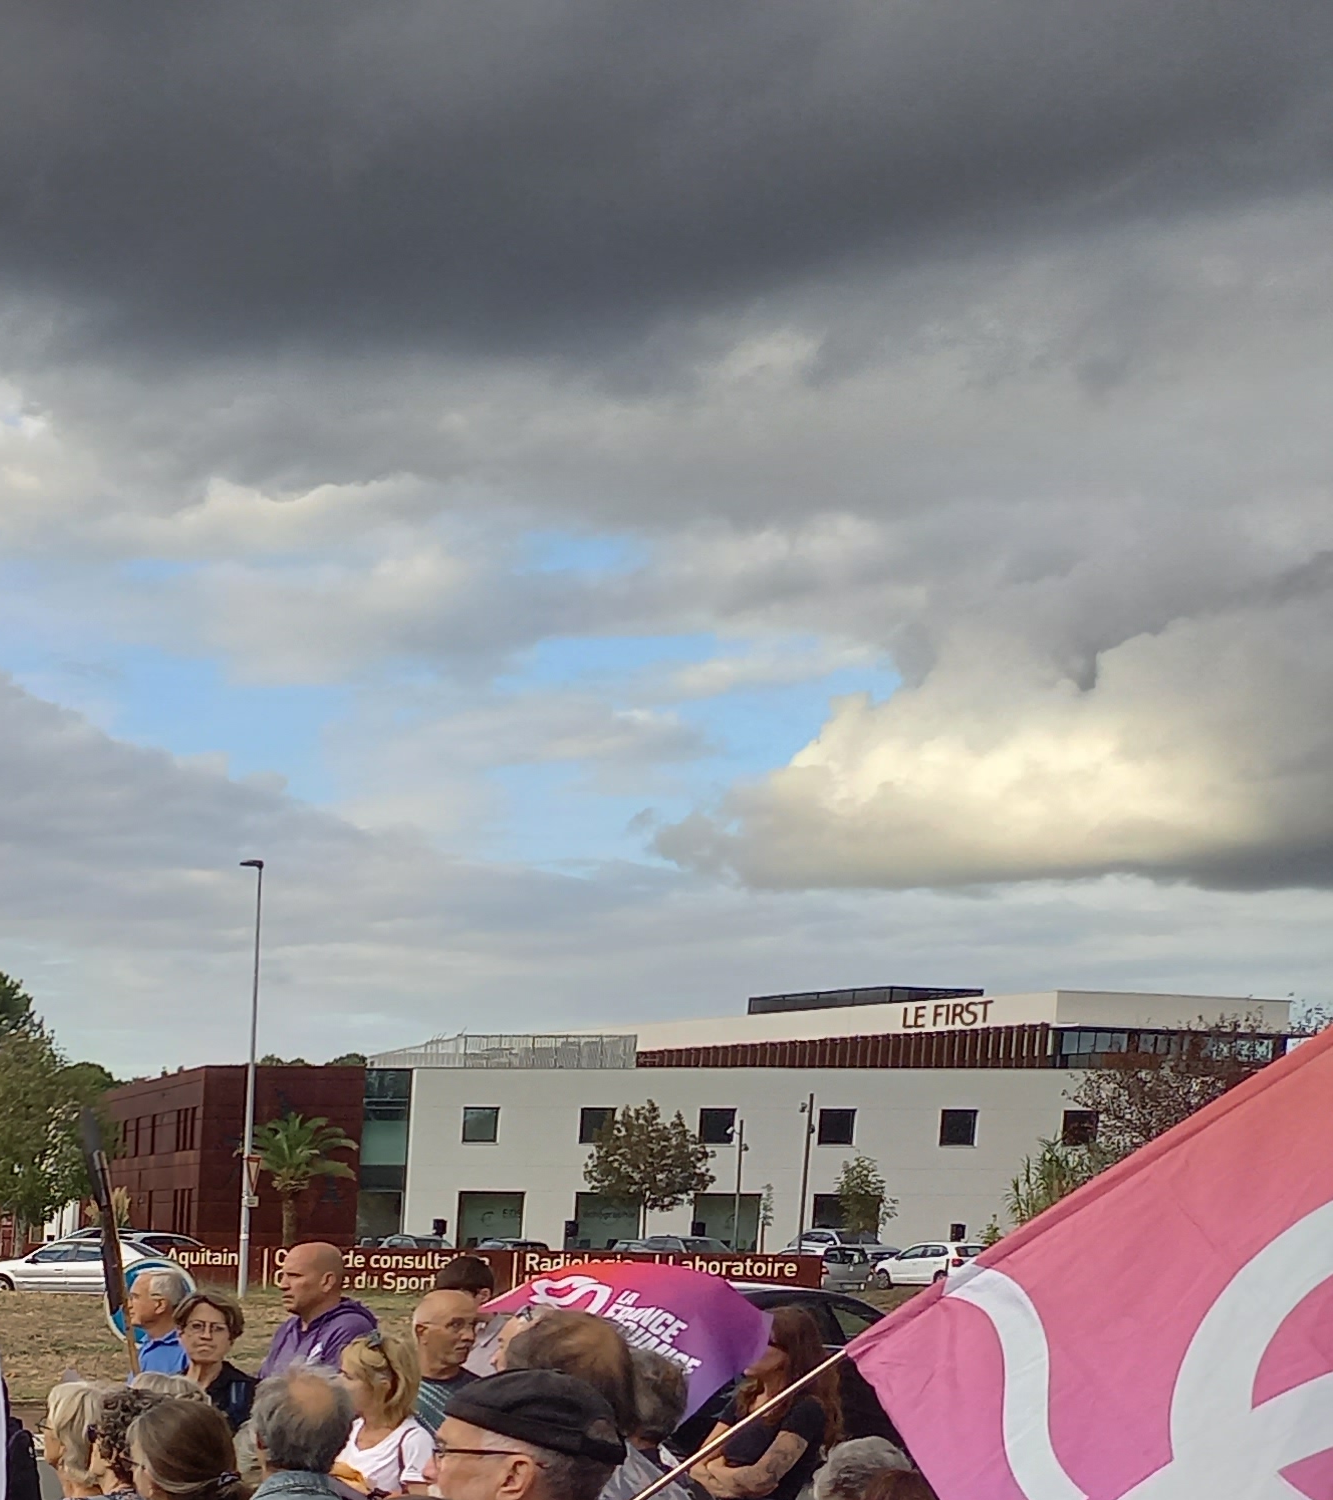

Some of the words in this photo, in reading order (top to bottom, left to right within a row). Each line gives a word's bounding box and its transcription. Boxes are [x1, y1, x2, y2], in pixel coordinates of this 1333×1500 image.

[902, 1006, 926, 1029] LE
[932, 1000, 994, 1027] FIRST
[167, 1249, 239, 1268] Aquitain
[343, 1249, 364, 1268] de
[355, 1273, 378, 1290] du
[383, 1273, 436, 1295] Sport
[615, 1290, 640, 1305] LA
[602, 1303, 689, 1344] FRANCE
